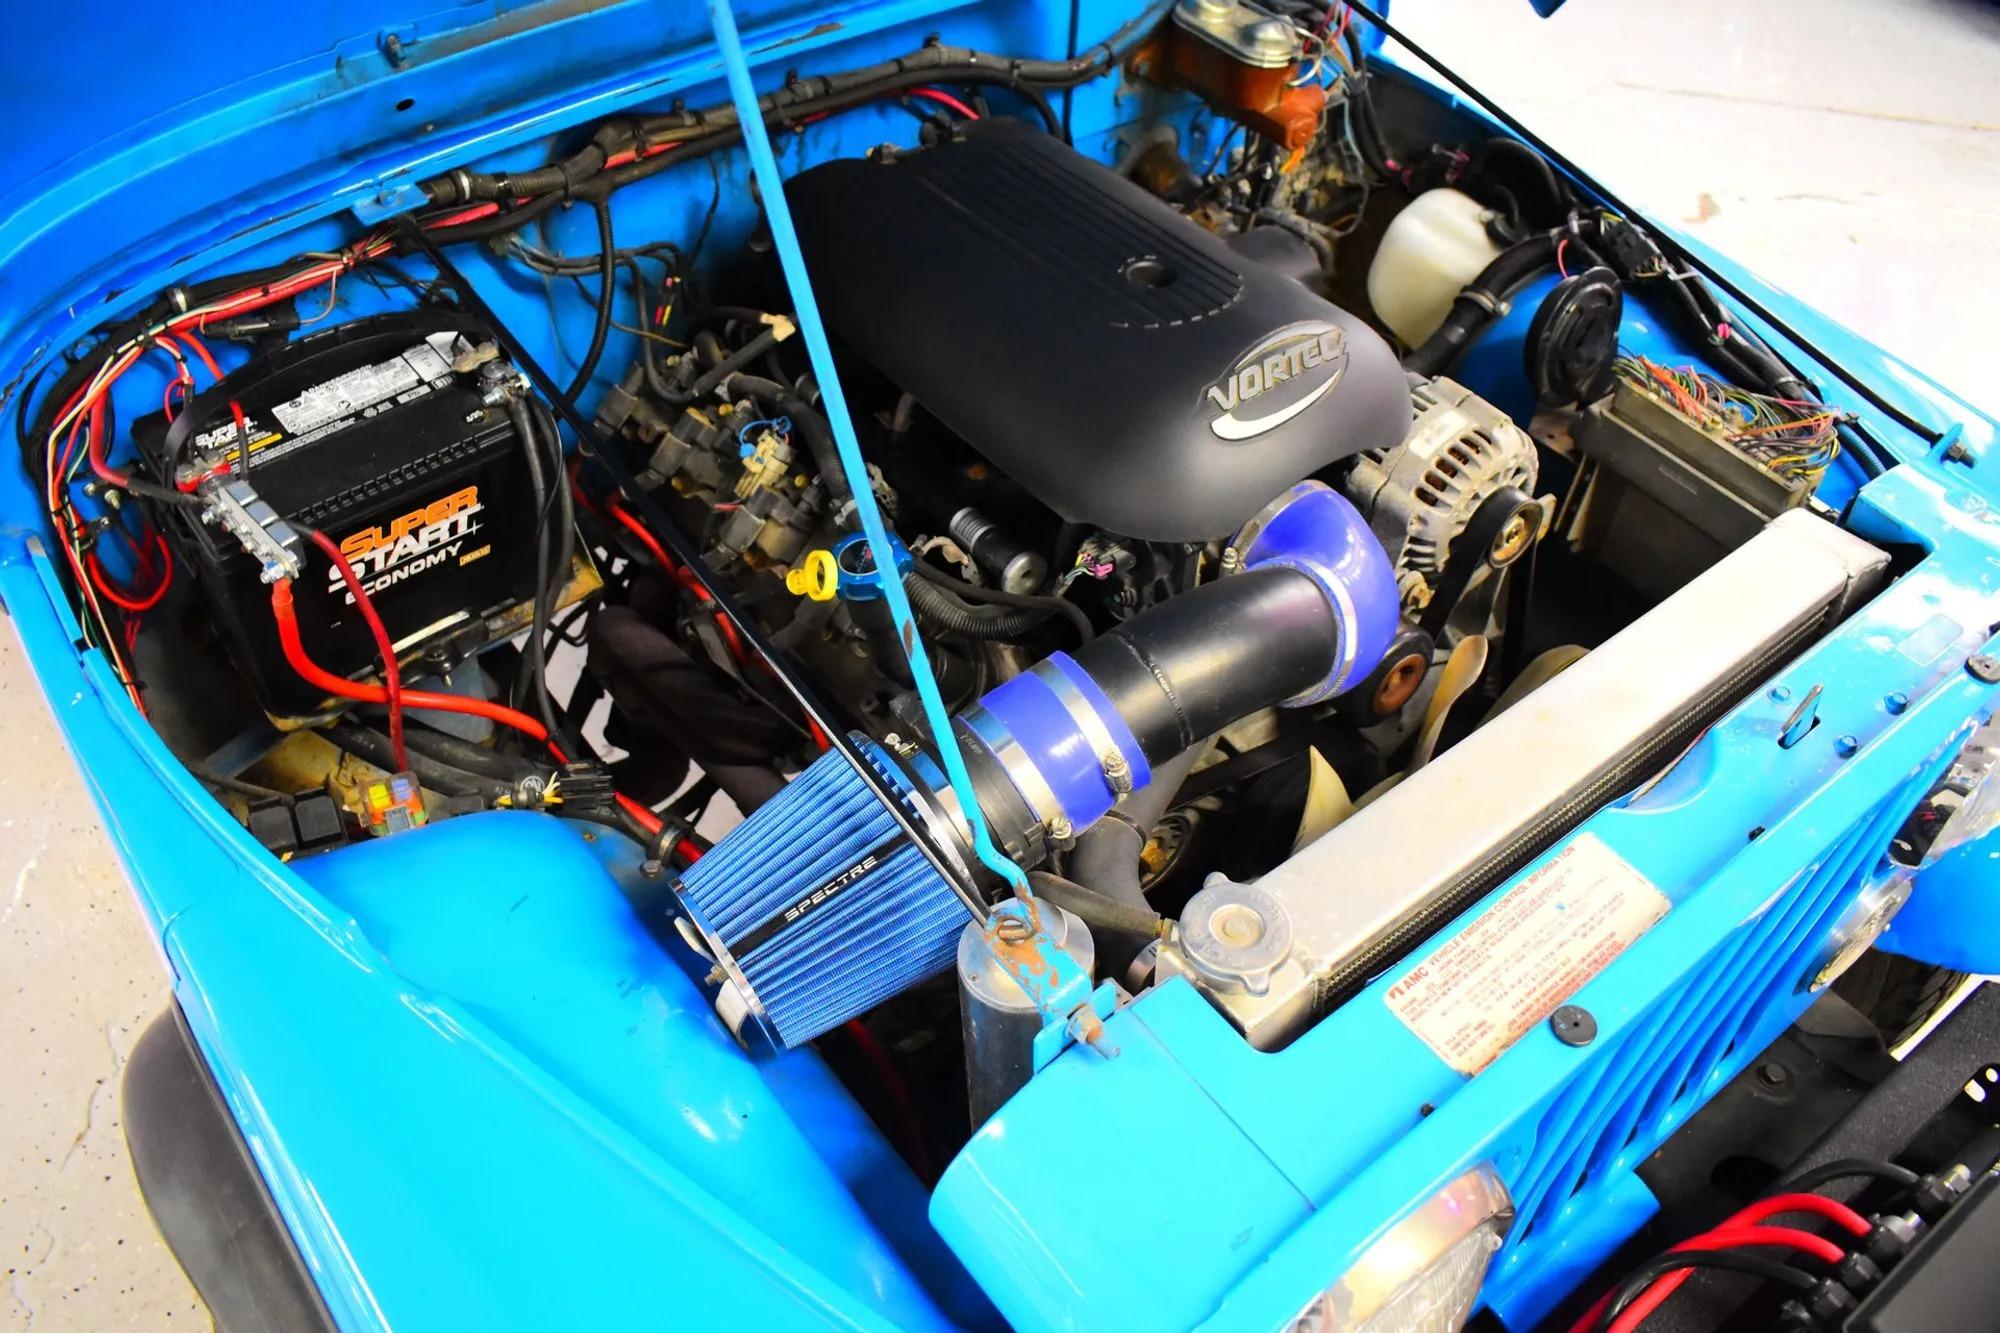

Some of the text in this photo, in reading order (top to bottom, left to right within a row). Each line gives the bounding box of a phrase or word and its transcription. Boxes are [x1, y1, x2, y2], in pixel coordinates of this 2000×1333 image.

[1206, 327, 1348, 411] VORTEC
[328, 502, 483, 593] START
[340, 485, 478, 558] SUPER
[345, 541, 462, 605] ECONOMY
[784, 856, 877, 922] SPECTRE
[1403, 846, 1575, 990] AMC VEHICLE EMISSION CONTROL INFORMATION
